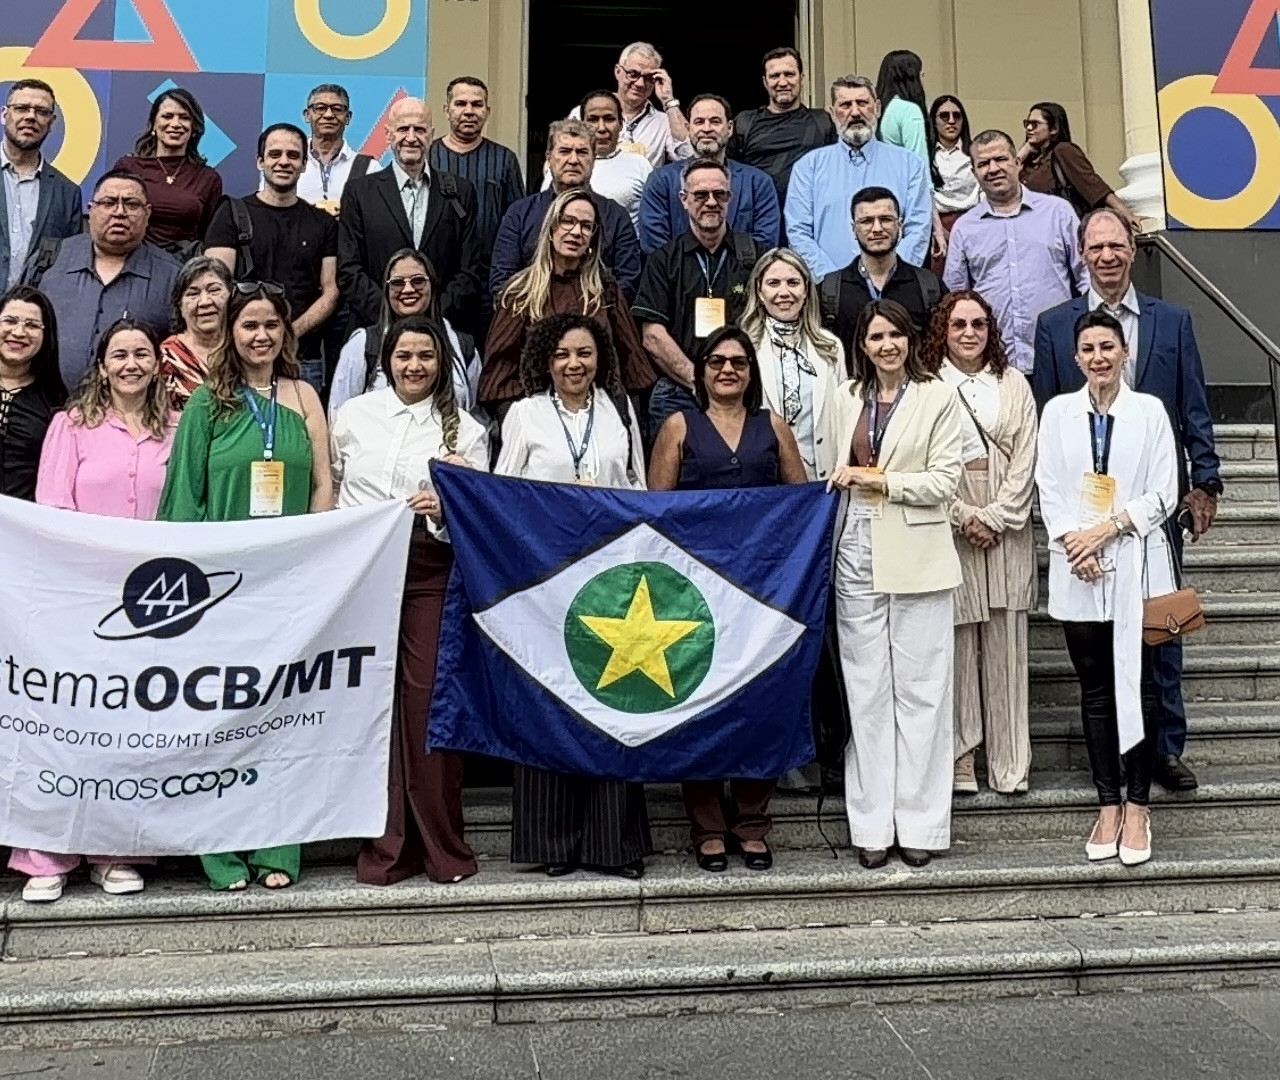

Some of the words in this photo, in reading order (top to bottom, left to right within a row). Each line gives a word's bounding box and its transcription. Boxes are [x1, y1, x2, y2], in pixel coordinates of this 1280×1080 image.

[53, 727, 113, 748] CO/TO
[127, 732, 202, 749] OCB/MT
[213, 710, 326, 745] SESCOOP/MT
